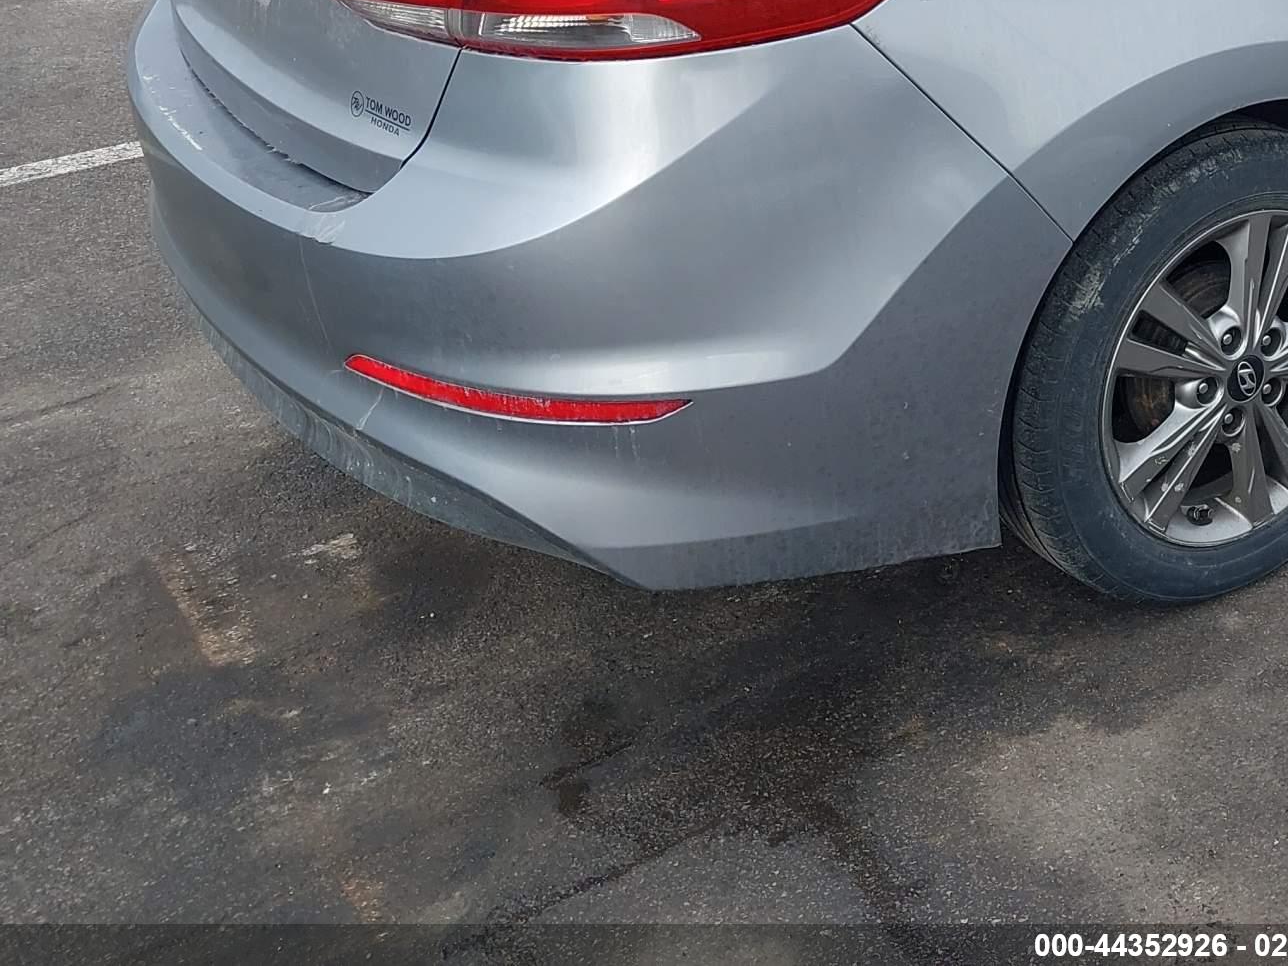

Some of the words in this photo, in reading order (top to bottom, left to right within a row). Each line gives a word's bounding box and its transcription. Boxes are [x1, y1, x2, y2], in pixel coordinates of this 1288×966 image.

[365, 96, 383, 115] TOM
[384, 105, 412, 127] WOOD
[370, 116, 400, 136] HONDA
